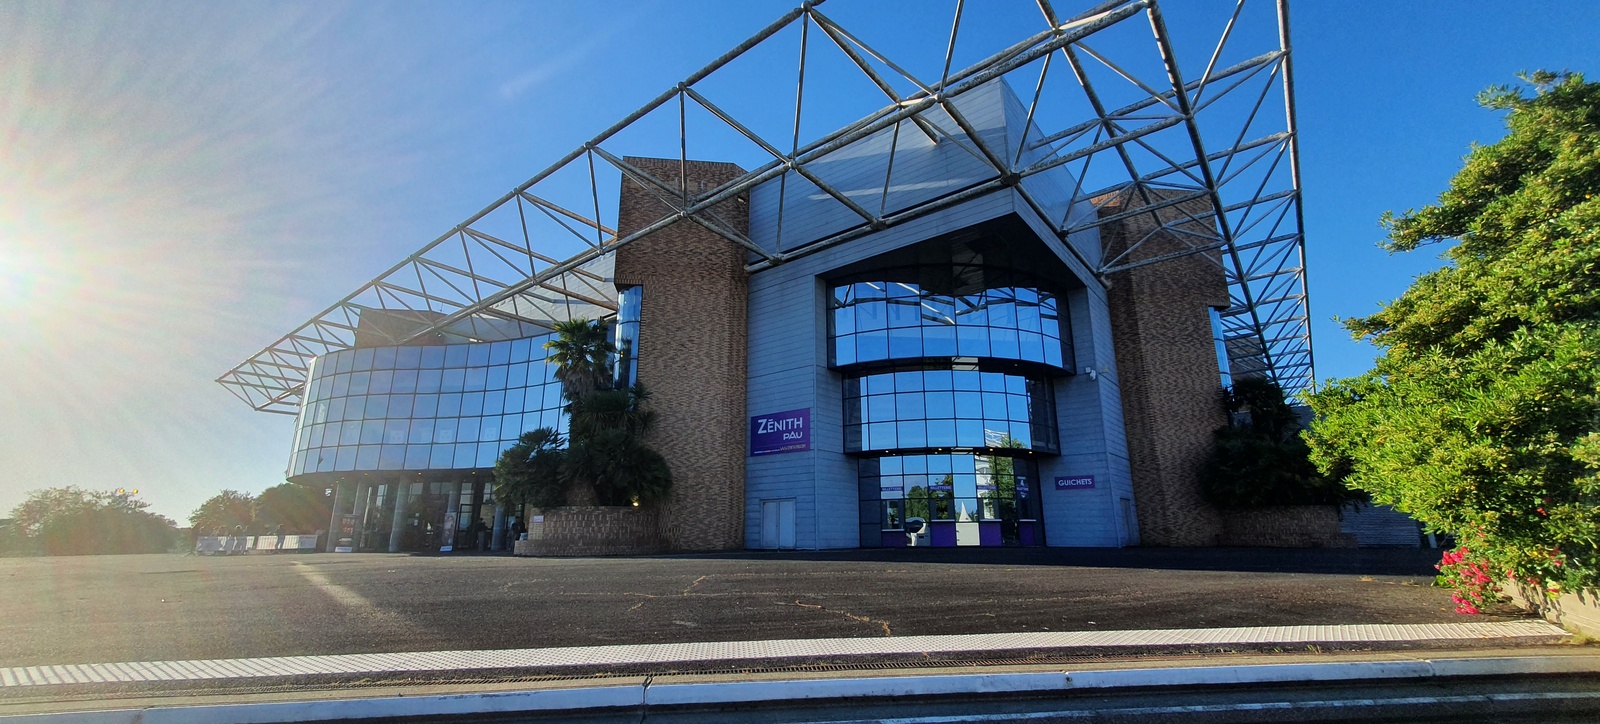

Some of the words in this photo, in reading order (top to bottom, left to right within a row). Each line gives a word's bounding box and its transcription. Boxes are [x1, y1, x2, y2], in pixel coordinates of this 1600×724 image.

[757, 417, 803, 434] ZÉNITH
[783, 431, 803, 440] PAU
[1058, 478, 1092, 486] GUICHETS
